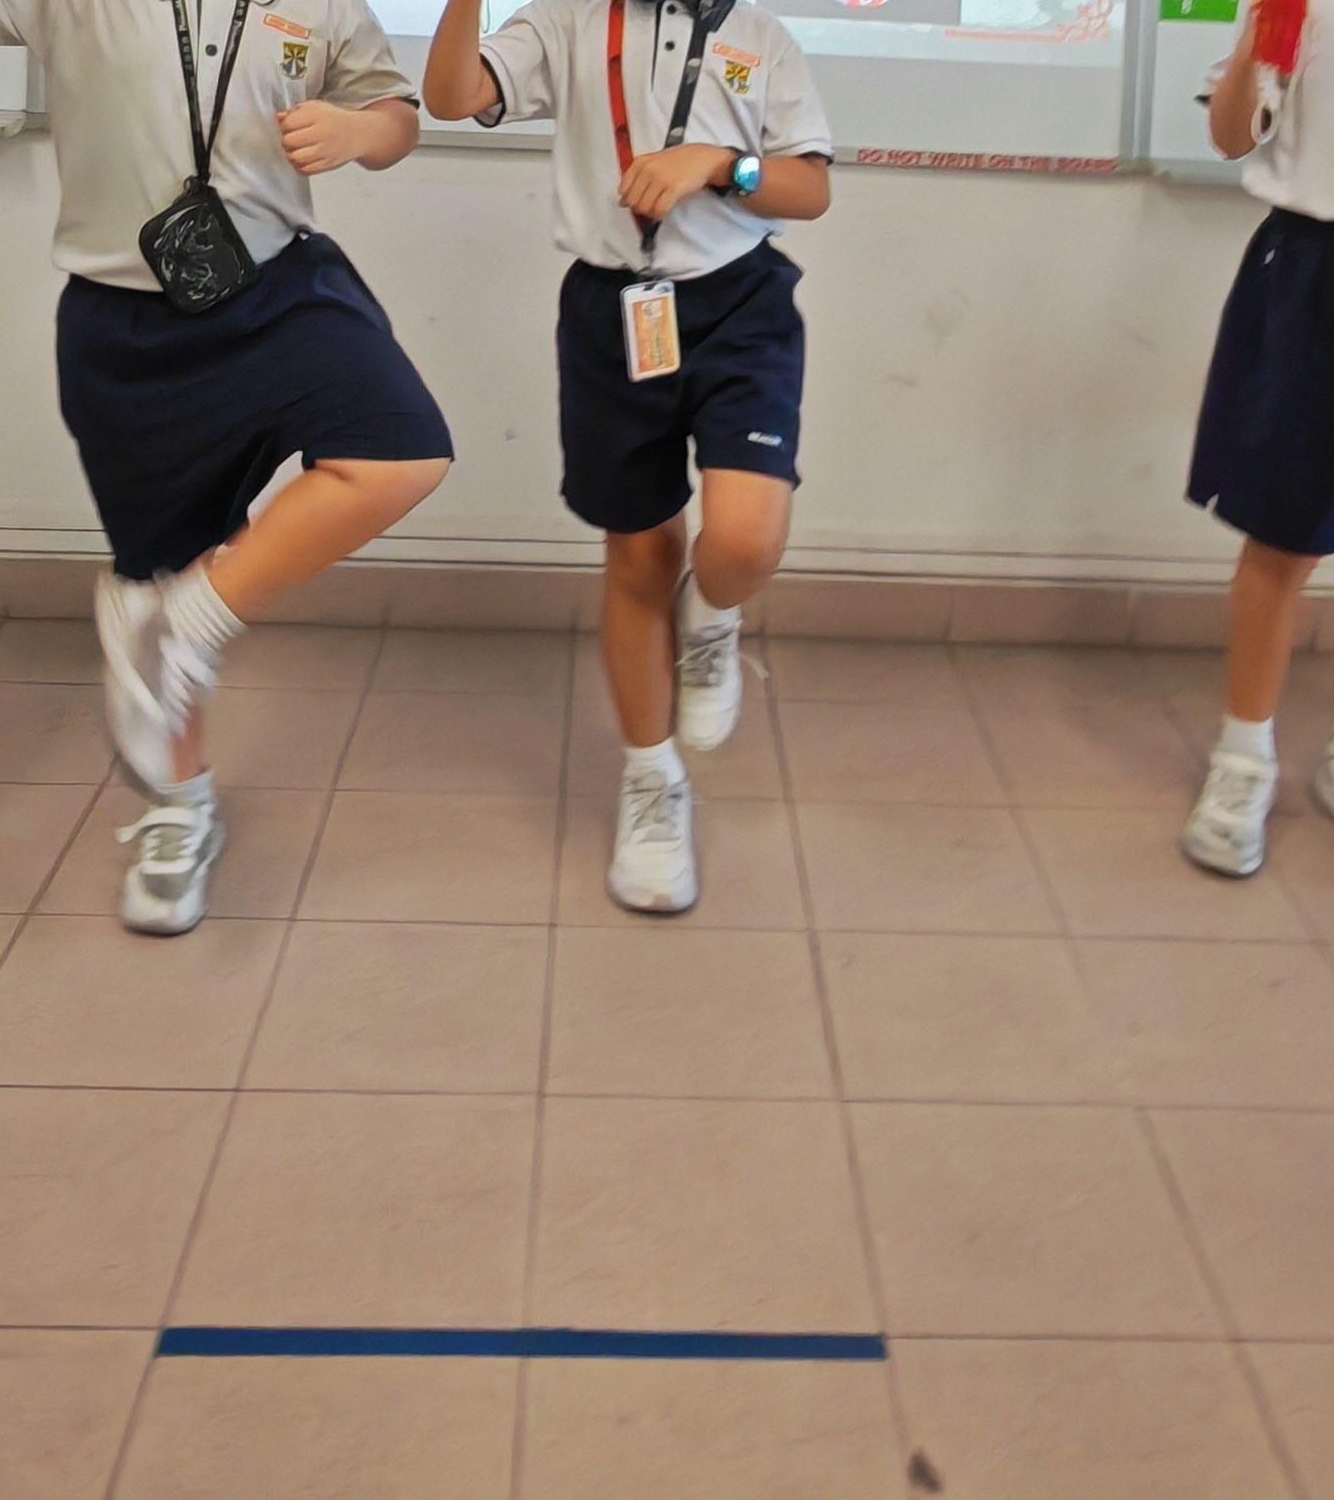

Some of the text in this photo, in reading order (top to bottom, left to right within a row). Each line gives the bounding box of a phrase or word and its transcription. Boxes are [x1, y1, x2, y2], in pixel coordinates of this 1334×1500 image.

[857, 148, 883, 164] DO
[888, 150, 920, 166] NOT
[928, 151, 983, 169] WRITE
